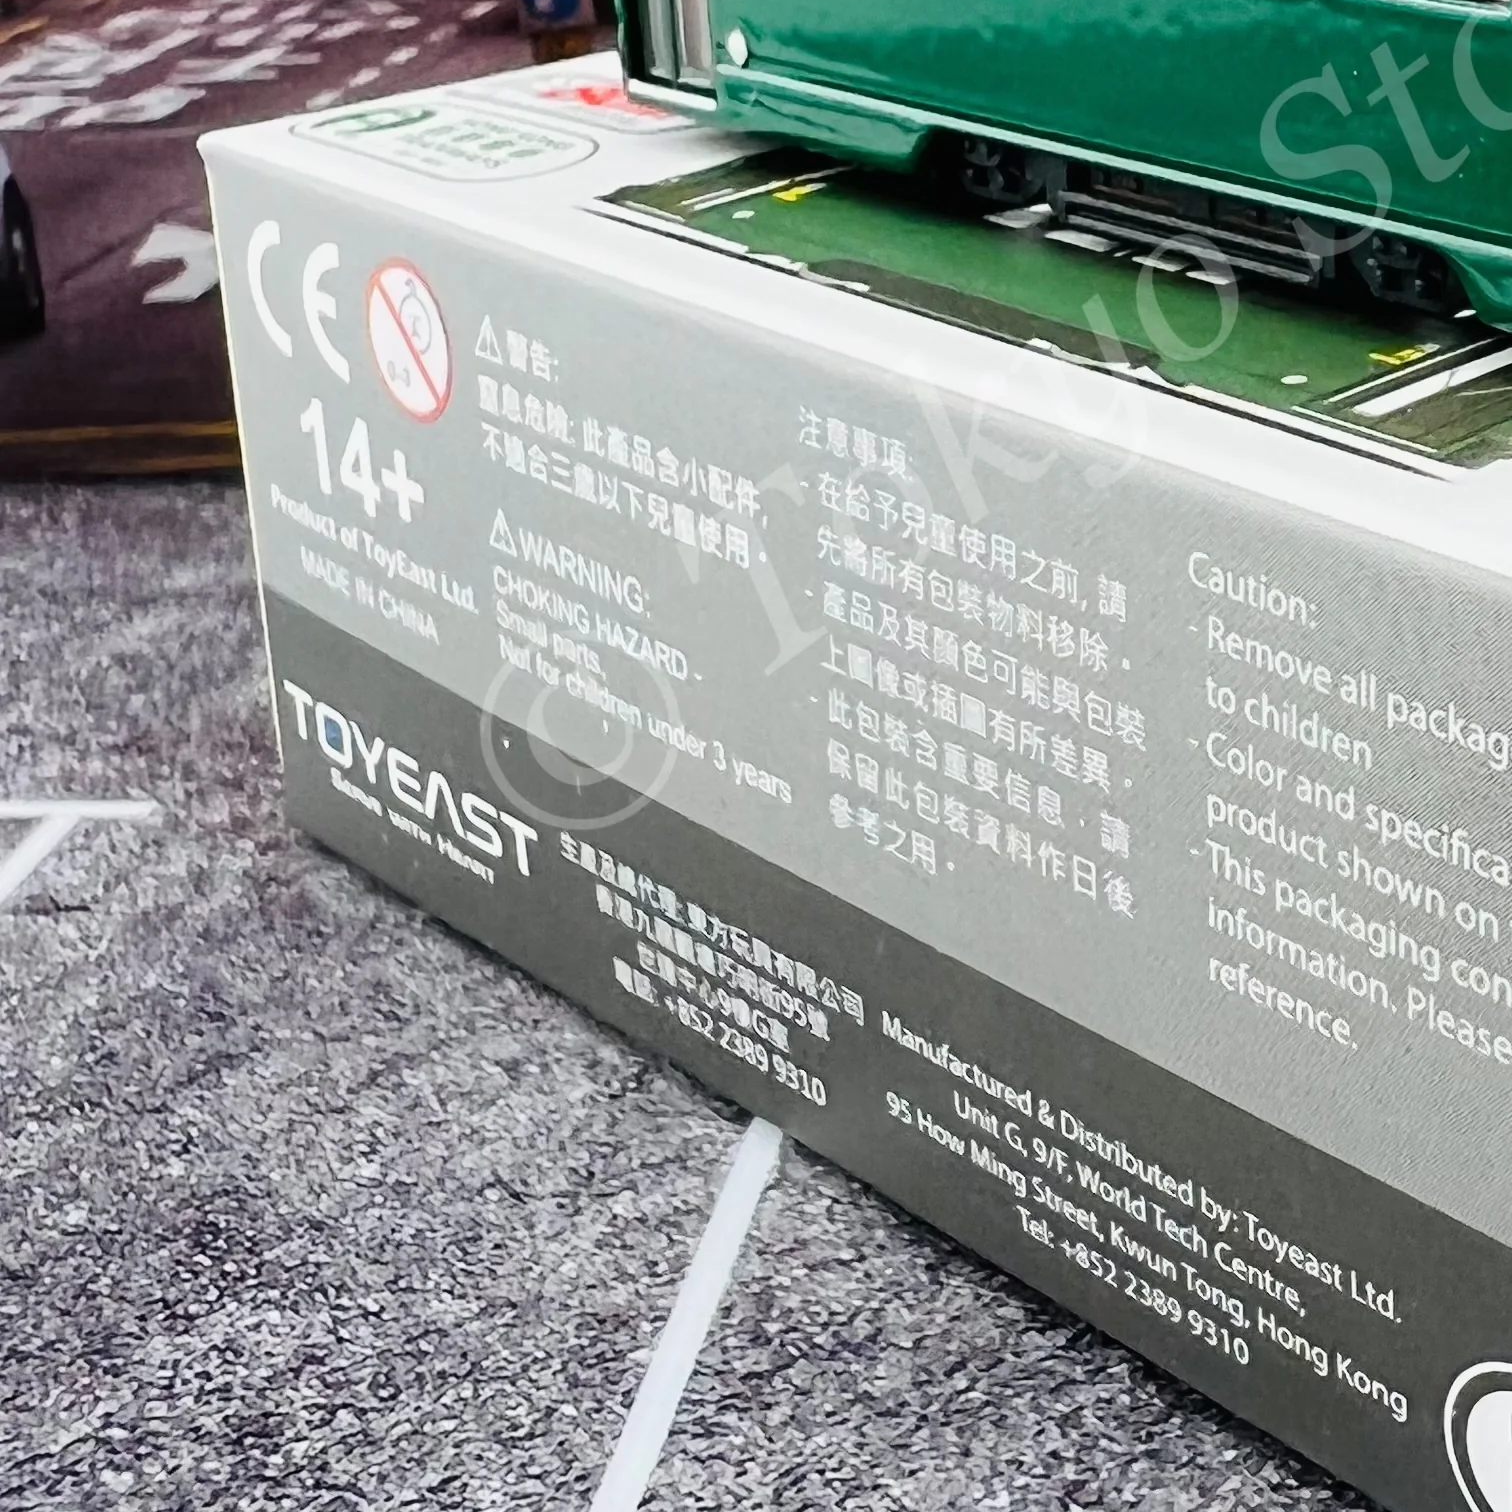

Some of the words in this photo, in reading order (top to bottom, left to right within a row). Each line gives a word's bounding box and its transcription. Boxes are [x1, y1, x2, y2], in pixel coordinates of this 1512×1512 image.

[246, 220, 351, 383] CE
[300, 396, 425, 524] 14+
[300, 544, 350, 596] MADE
[355, 576, 375, 609] IN
[378, 588, 440, 646] CHINA
[493, 565, 590, 634] CHOKING
[595, 613, 688, 681] HAZARD
[496, 600, 548, 648] Small
[518, 527, 650, 619] WARNING:
[1188, 551, 1318, 629] Caution:
[498, 634, 532, 674] Not
[535, 652, 561, 686] for
[565, 672, 643, 729] children
[647, 712, 707, 760] under
[713, 741, 726, 772] 3
[731, 757, 793, 804] years
[1206, 675, 1236, 714] to
[1244, 692, 1373, 771] children
[1207, 616, 1333, 696] Remove
[1340, 672, 1378, 713] all
[282, 678, 538, 877] TOYEAST
[1206, 732, 1289, 792] Color
[1296, 772, 1356, 820] and
[1206, 793, 1329, 869] product
[1337, 845, 1446, 918] shown
[1454, 901, 1499, 943] on
[1206, 838, 1267, 896] This
[1275, 879, 1441, 982] packaging
[1206, 896, 1399, 1015] information.
[1208, 956, 1359, 1051] reference.
[771, 1053, 827, 1106] 9310
[881, 1010, 1033, 1117] Manufactured
[1037, 1098, 1055, 1129] &
[1059, 1109, 1194, 1208] Distributed
[1200, 1186, 1239, 1233] by:
[1243, 1210, 1343, 1293] Toyeast
[1351, 1270, 1402, 1324] Ltd.
[953, 1090, 1000, 1140] Unit
[1075, 1160, 1147, 1223] World
[1150, 1202, 1208, 1258] Tech
[1214, 1241, 1306, 1317] Centre,
[885, 1091, 912, 1125] 95
[916, 1108, 965, 1156] How
[970, 1138, 1027, 1198] Ming
[1032, 1176, 1104, 1244] Street,
[1110, 1220, 1177, 1282] Kwun
[1181, 1261, 1251, 1329] Tong,
[1258, 1306, 1329, 1377] Hong
[1337, 1351, 1408, 1423] Kong
[1059, 1239, 1118, 1289] +852
[1124, 1270, 1182, 1324] 2389
[1187, 1309, 1250, 1365] 9310
